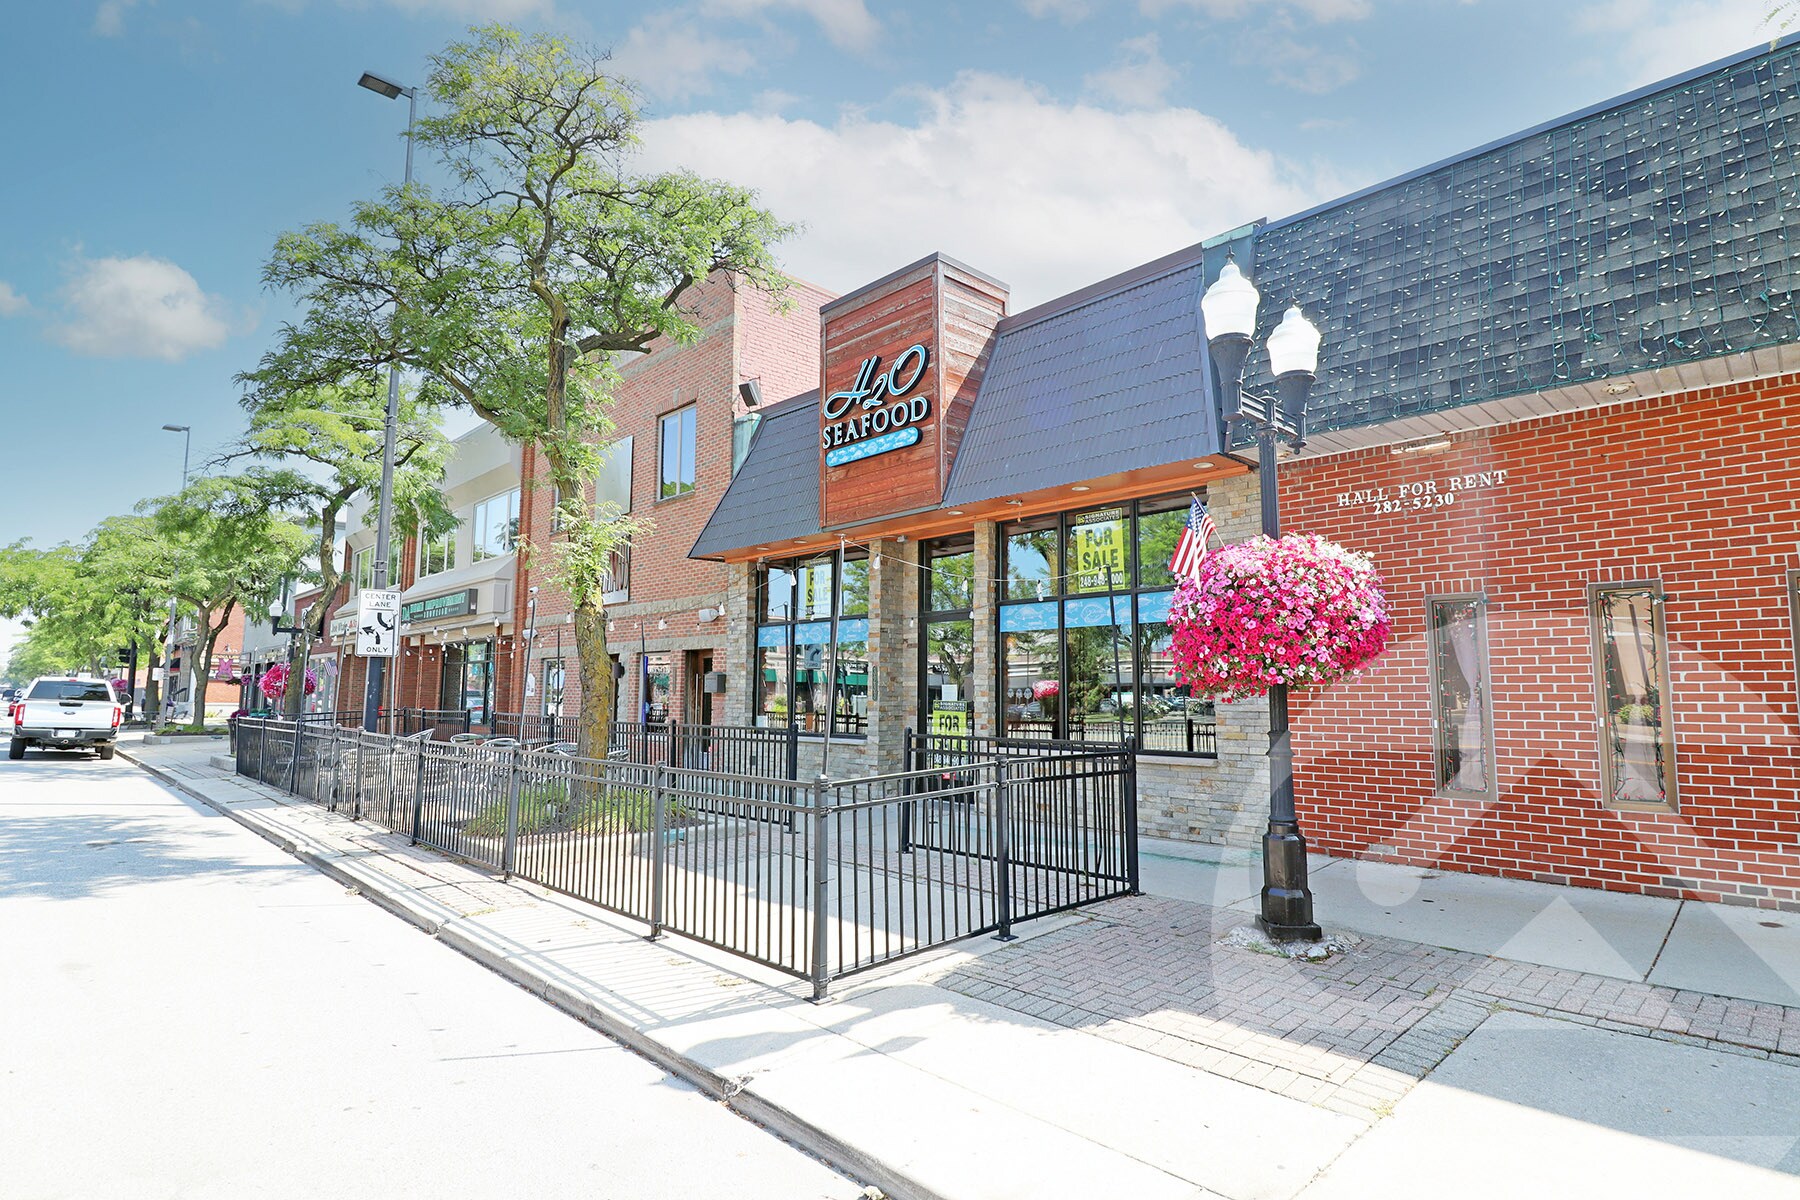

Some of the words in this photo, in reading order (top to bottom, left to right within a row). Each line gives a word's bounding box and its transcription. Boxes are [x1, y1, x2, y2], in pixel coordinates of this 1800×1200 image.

[823, 344, 928, 420] H2O
[822, 396, 930, 449] SEAFOOD
[1337, 488, 1388, 507] HALL
[1398, 480, 1437, 498] FOR
[1449, 470, 1507, 491] RENT
[1373, 493, 1455, 515] 282-5230
[1085, 509, 1120, 519] SIGNATURE
[1085, 515, 1120, 524] ASSOCIATES
[1085, 526, 1113, 548] FOR
[1083, 549, 1119, 571] SALE
[810, 570, 826, 585] FOR
[1080, 572, 1123, 587] 248-948-000
[365, 592, 397, 600] CENTER
[808, 586, 829, 602] SALE
[939, 714, 960, 731] FOR
